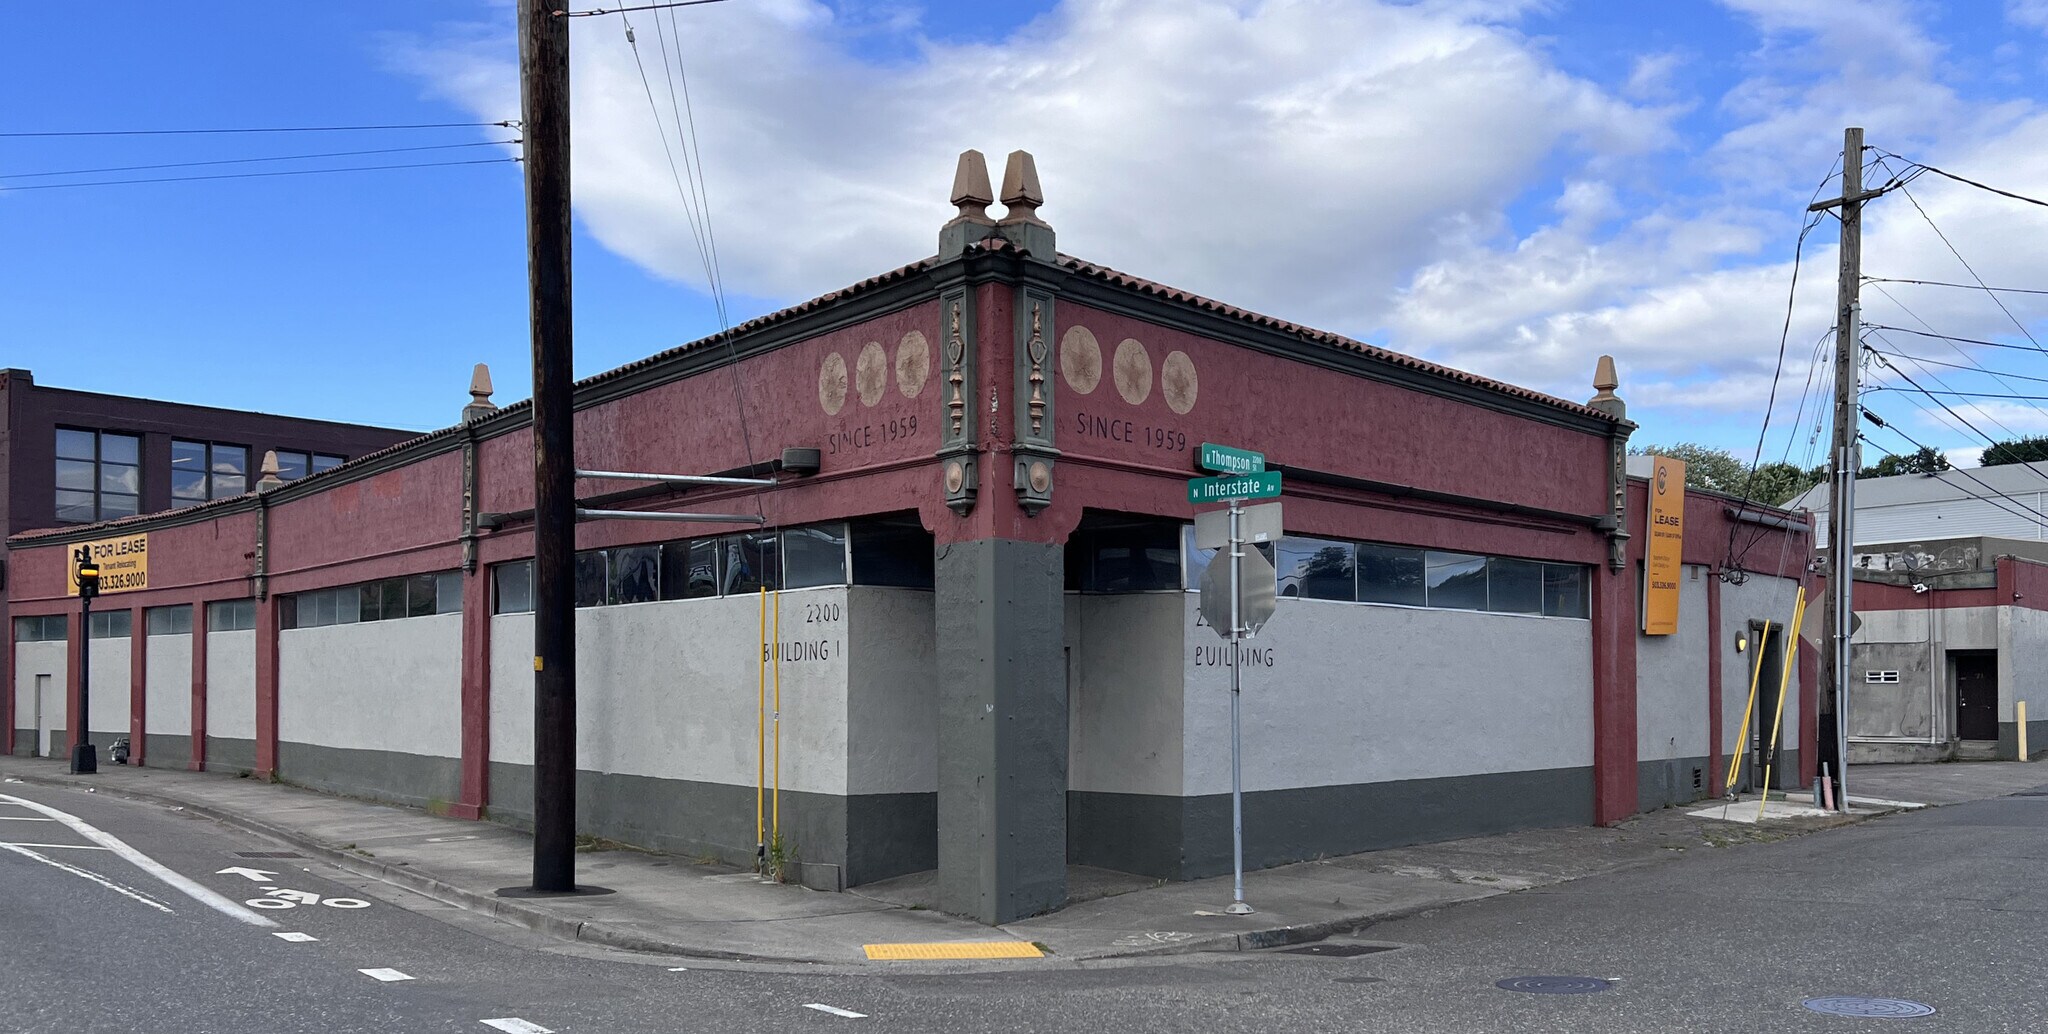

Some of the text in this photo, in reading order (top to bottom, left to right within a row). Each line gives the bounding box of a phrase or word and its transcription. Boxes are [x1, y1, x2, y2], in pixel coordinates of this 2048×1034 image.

[829, 415, 917, 455] SINCE 1959
[1077, 412, 1186, 452] SINCE 1959
[1206, 450, 1250, 471] N Thompson
[1193, 479, 1275, 498] N Interstate Av
[1654, 514, 1680, 527] LEASE
[94, 538, 146, 559] FOR LEASE
[98, 571, 146, 591] 03.326.9000
[806, 603, 840, 623] 2200
[763, 640, 829, 662] BUILDING
